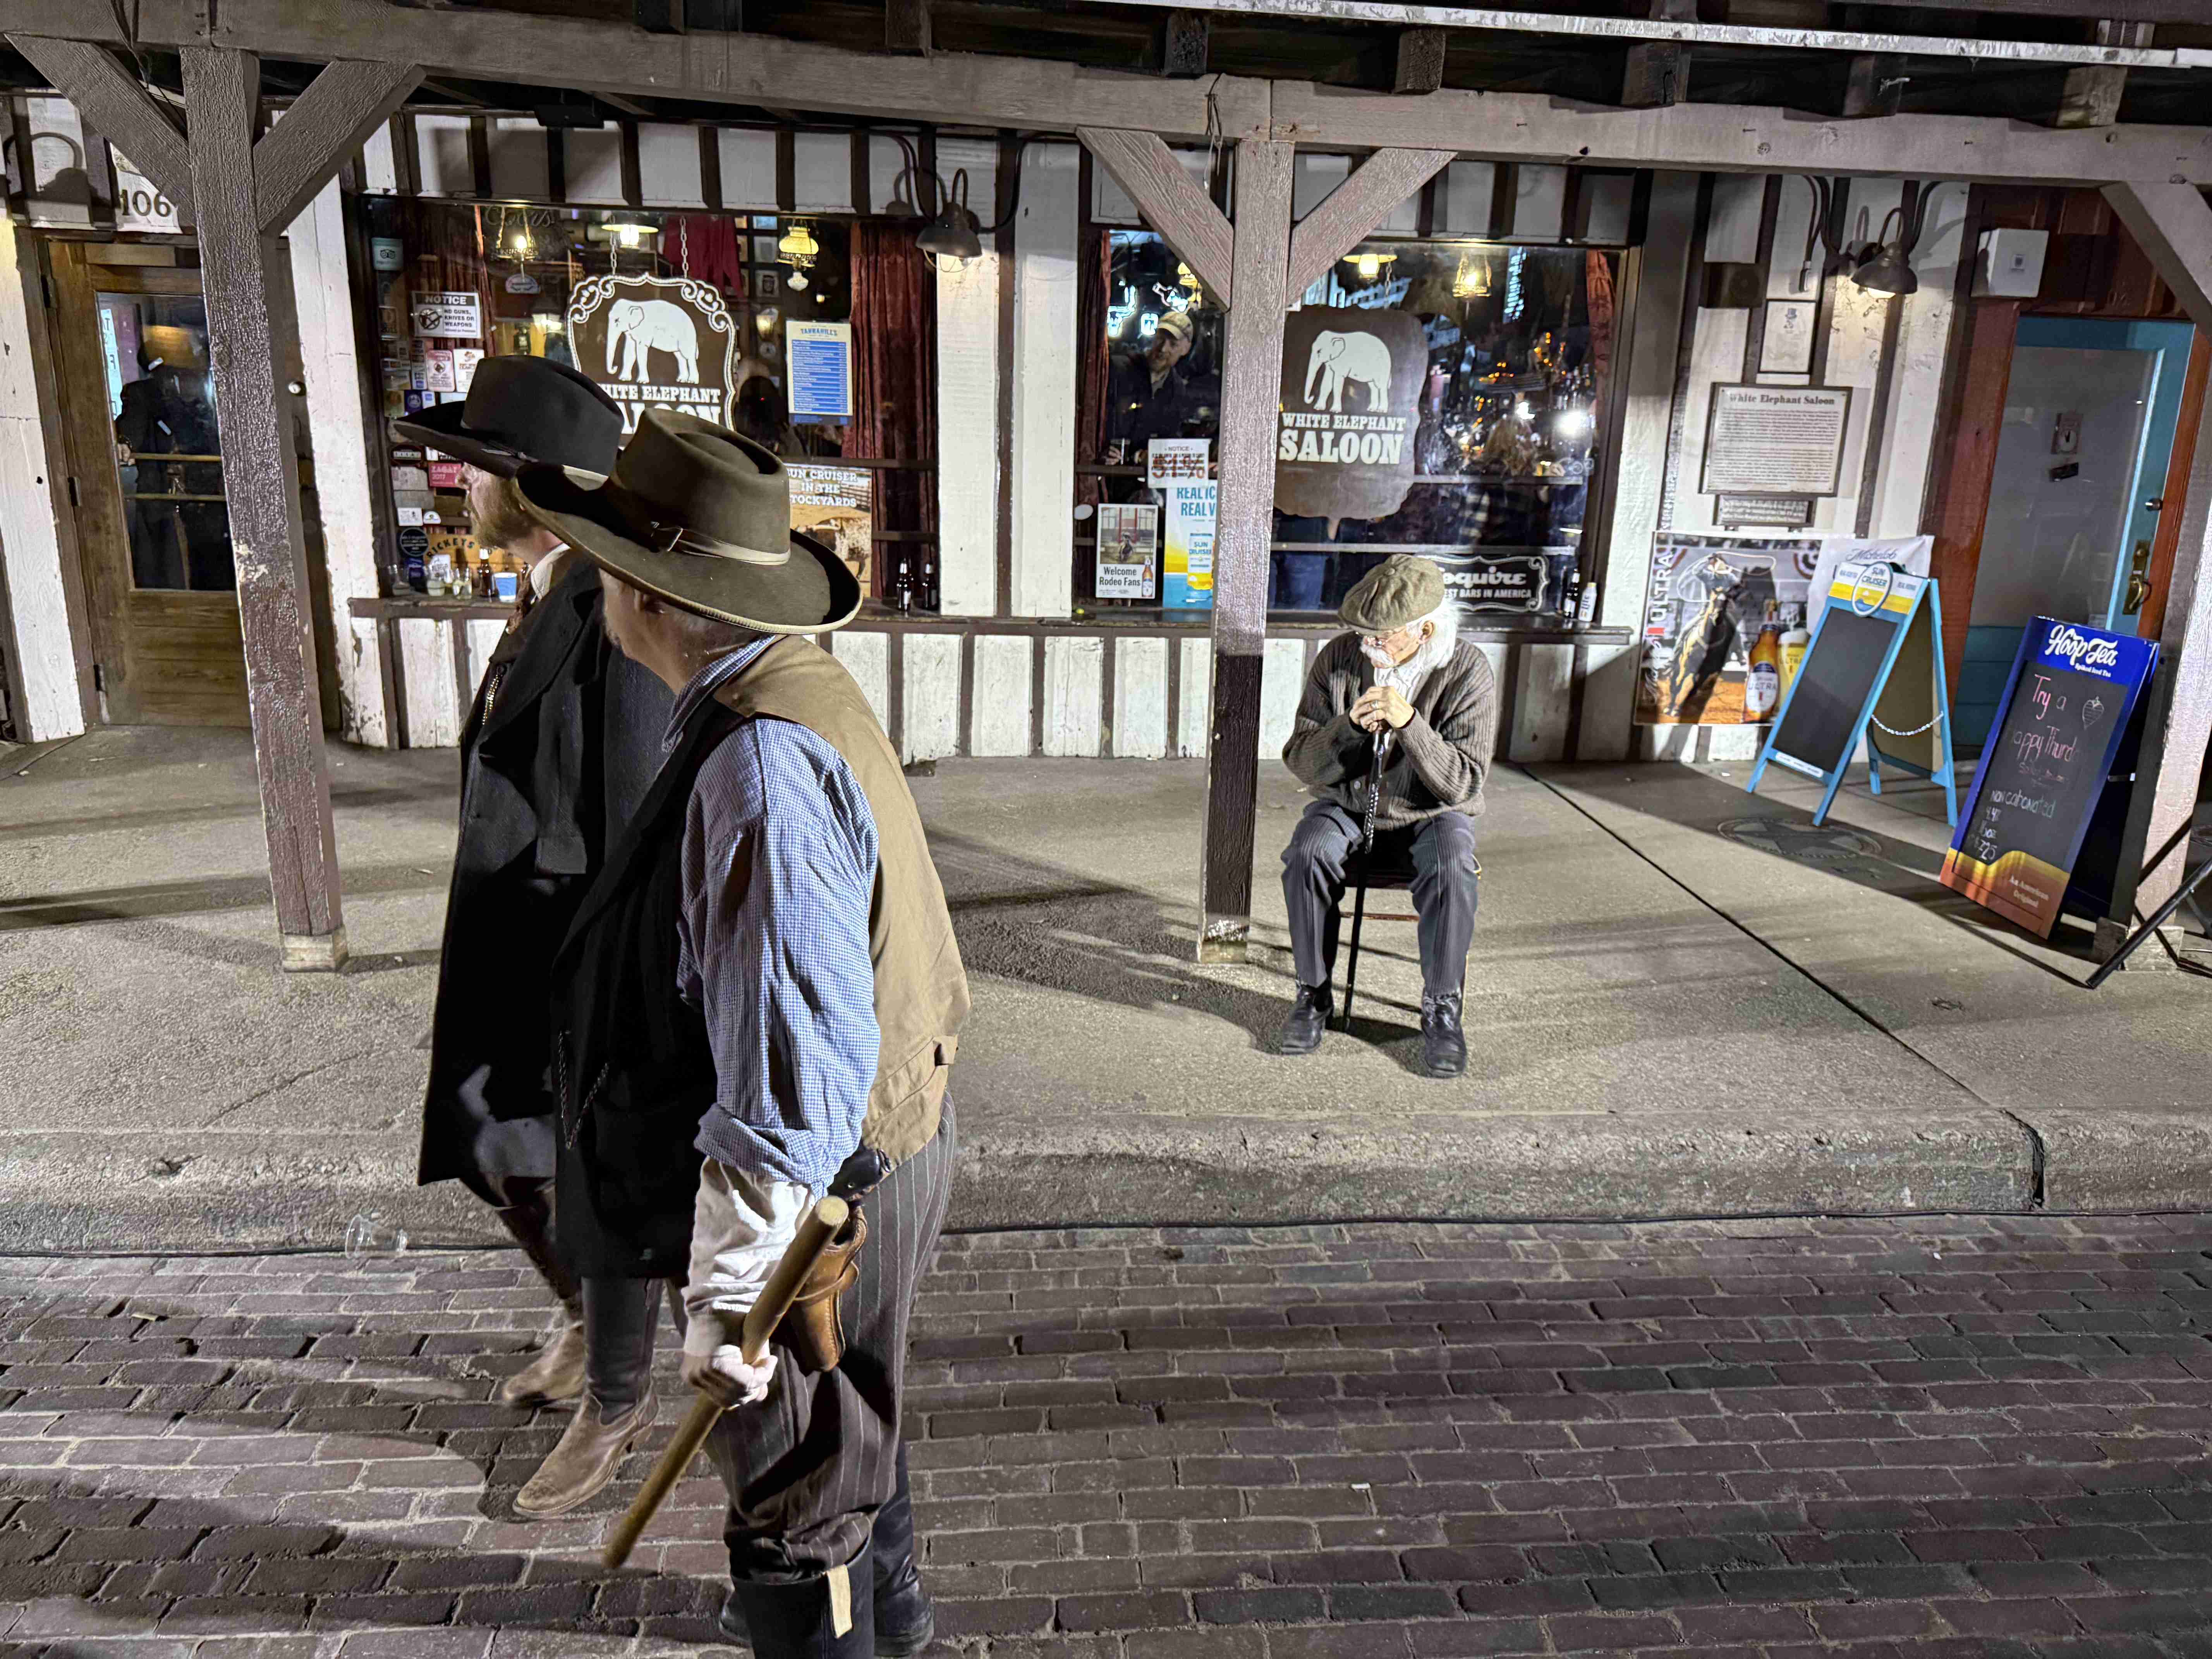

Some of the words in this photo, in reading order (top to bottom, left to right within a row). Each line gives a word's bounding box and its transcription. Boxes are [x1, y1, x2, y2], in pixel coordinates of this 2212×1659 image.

[120, 189, 171, 217] 106
[425, 295, 467, 305] NOTICE
[597, 383, 639, 400] HITE
[642, 385, 721, 403] ELEPHANT
[1729, 393, 1757, 402] White
[1760, 394, 1801, 405] Elephant
[1803, 395, 1835, 405] Saloon
[1281, 412, 1330, 429] WHITE
[1333, 415, 1407, 431] ELEPHANT
[1278, 428, 1405, 464] SALOON
[810, 470, 857, 482] CRUISER
[802, 483, 813, 492] IN
[818, 484, 840, 493] THE
[790, 495, 857, 508] TOCKYARDS
[1181, 502, 1207, 516] REAL
[1846, 548, 1897, 562] Michelob
[1104, 566, 1137, 576] Welcome
[1438, 566, 1527, 589] squire
[1871, 567, 1886, 575] SUN
[1099, 577, 1122, 586] Rodeo
[1123, 577, 1141, 586] Fans
[1650, 553, 1674, 622] ULTRA
[1862, 575, 1887, 586] CRUISER
[1444, 589, 1458, 598] EST
[1459, 589, 1482, 598] BARS
[1483, 589, 1493, 598] IN
[1494, 589, 1532, 599] AMERICA
[2044, 624, 2088, 666] Hoop
[2085, 638, 2119, 666] Tea
[2032, 673, 2051, 720] Try
[2056, 696, 2067, 711] a
[2013, 731, 2044, 762] appy
